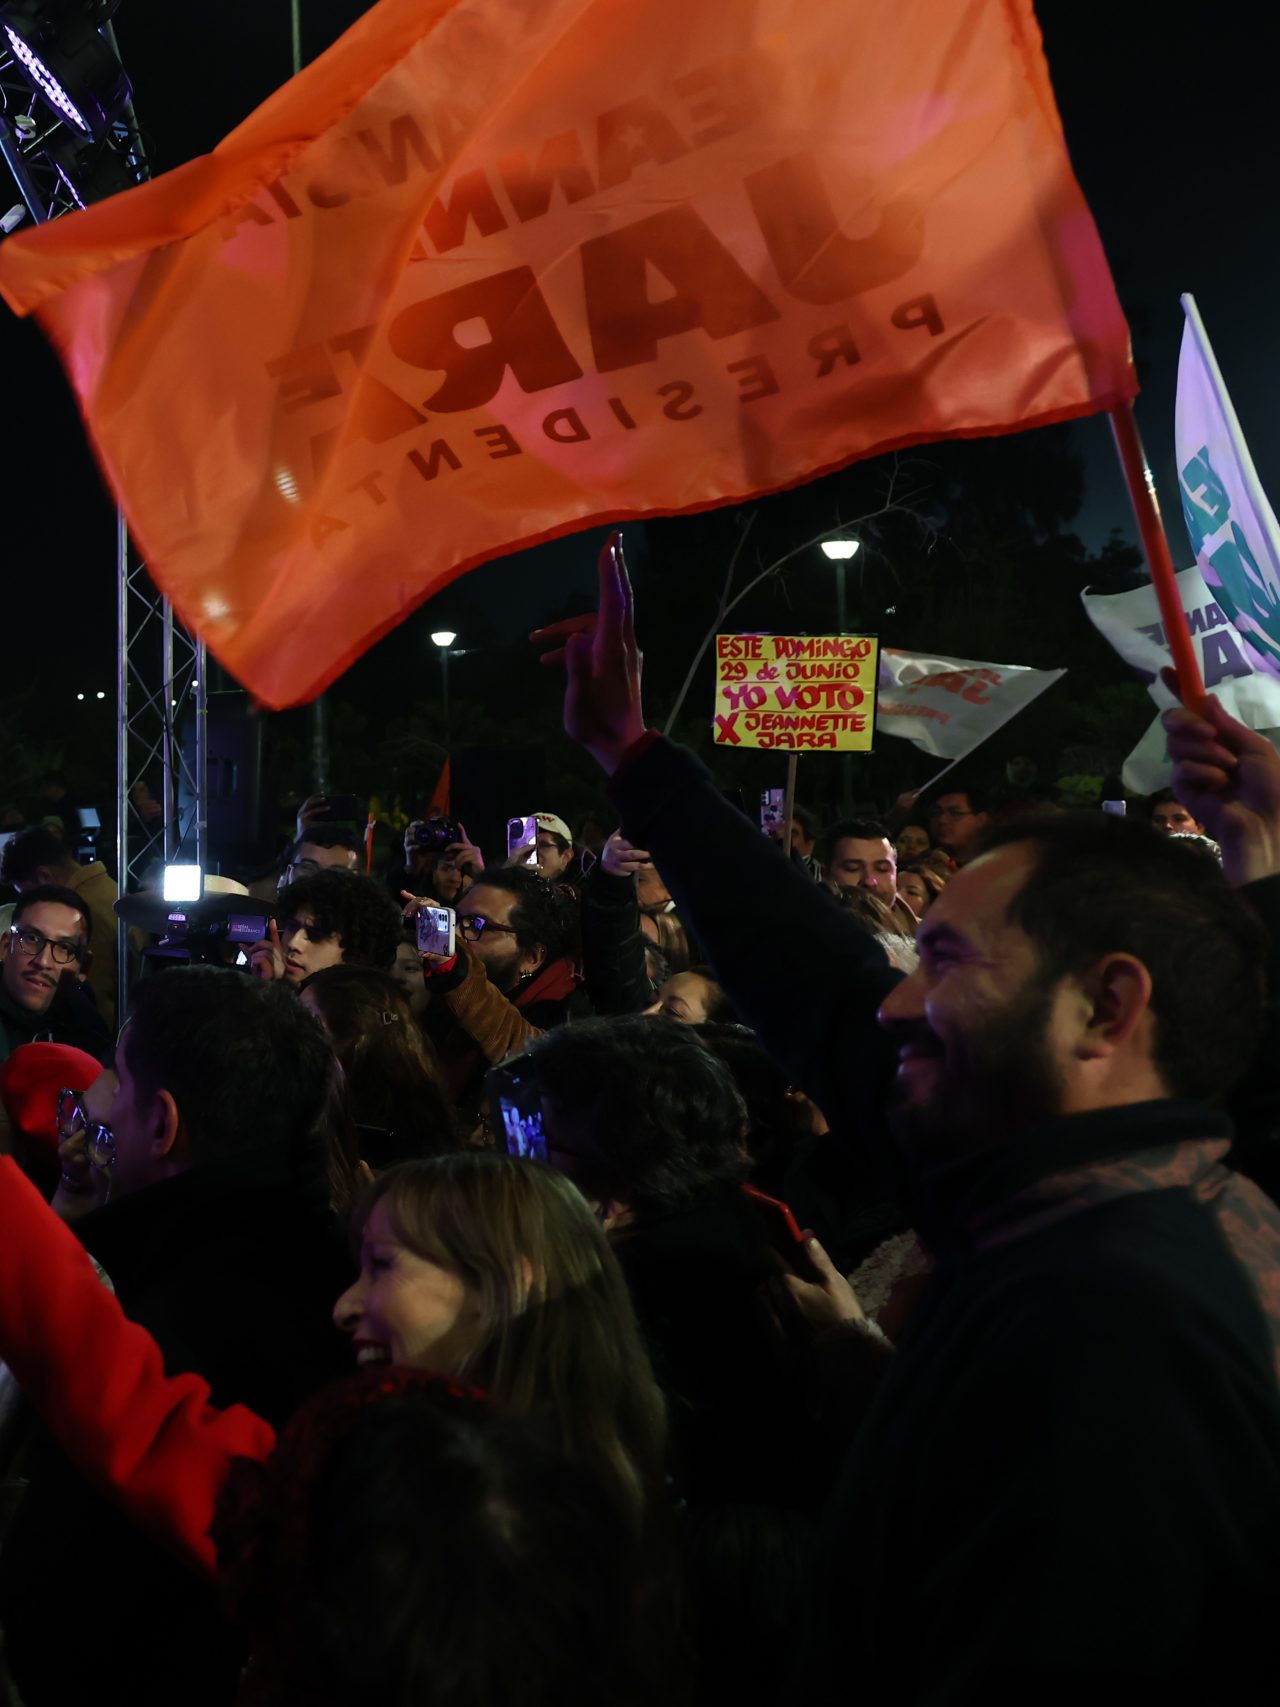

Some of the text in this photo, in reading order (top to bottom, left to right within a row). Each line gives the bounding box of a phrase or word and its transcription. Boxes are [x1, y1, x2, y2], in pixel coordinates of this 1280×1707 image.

[718, 636, 763, 658] ESTE
[720, 661, 748, 681] 29
[756, 661, 780, 681] de
[722, 683, 864, 710] YO VOTO
[715, 712, 741, 745] X
[745, 713, 867, 732] JEANNETTE
[756, 732, 837, 748] JARA
